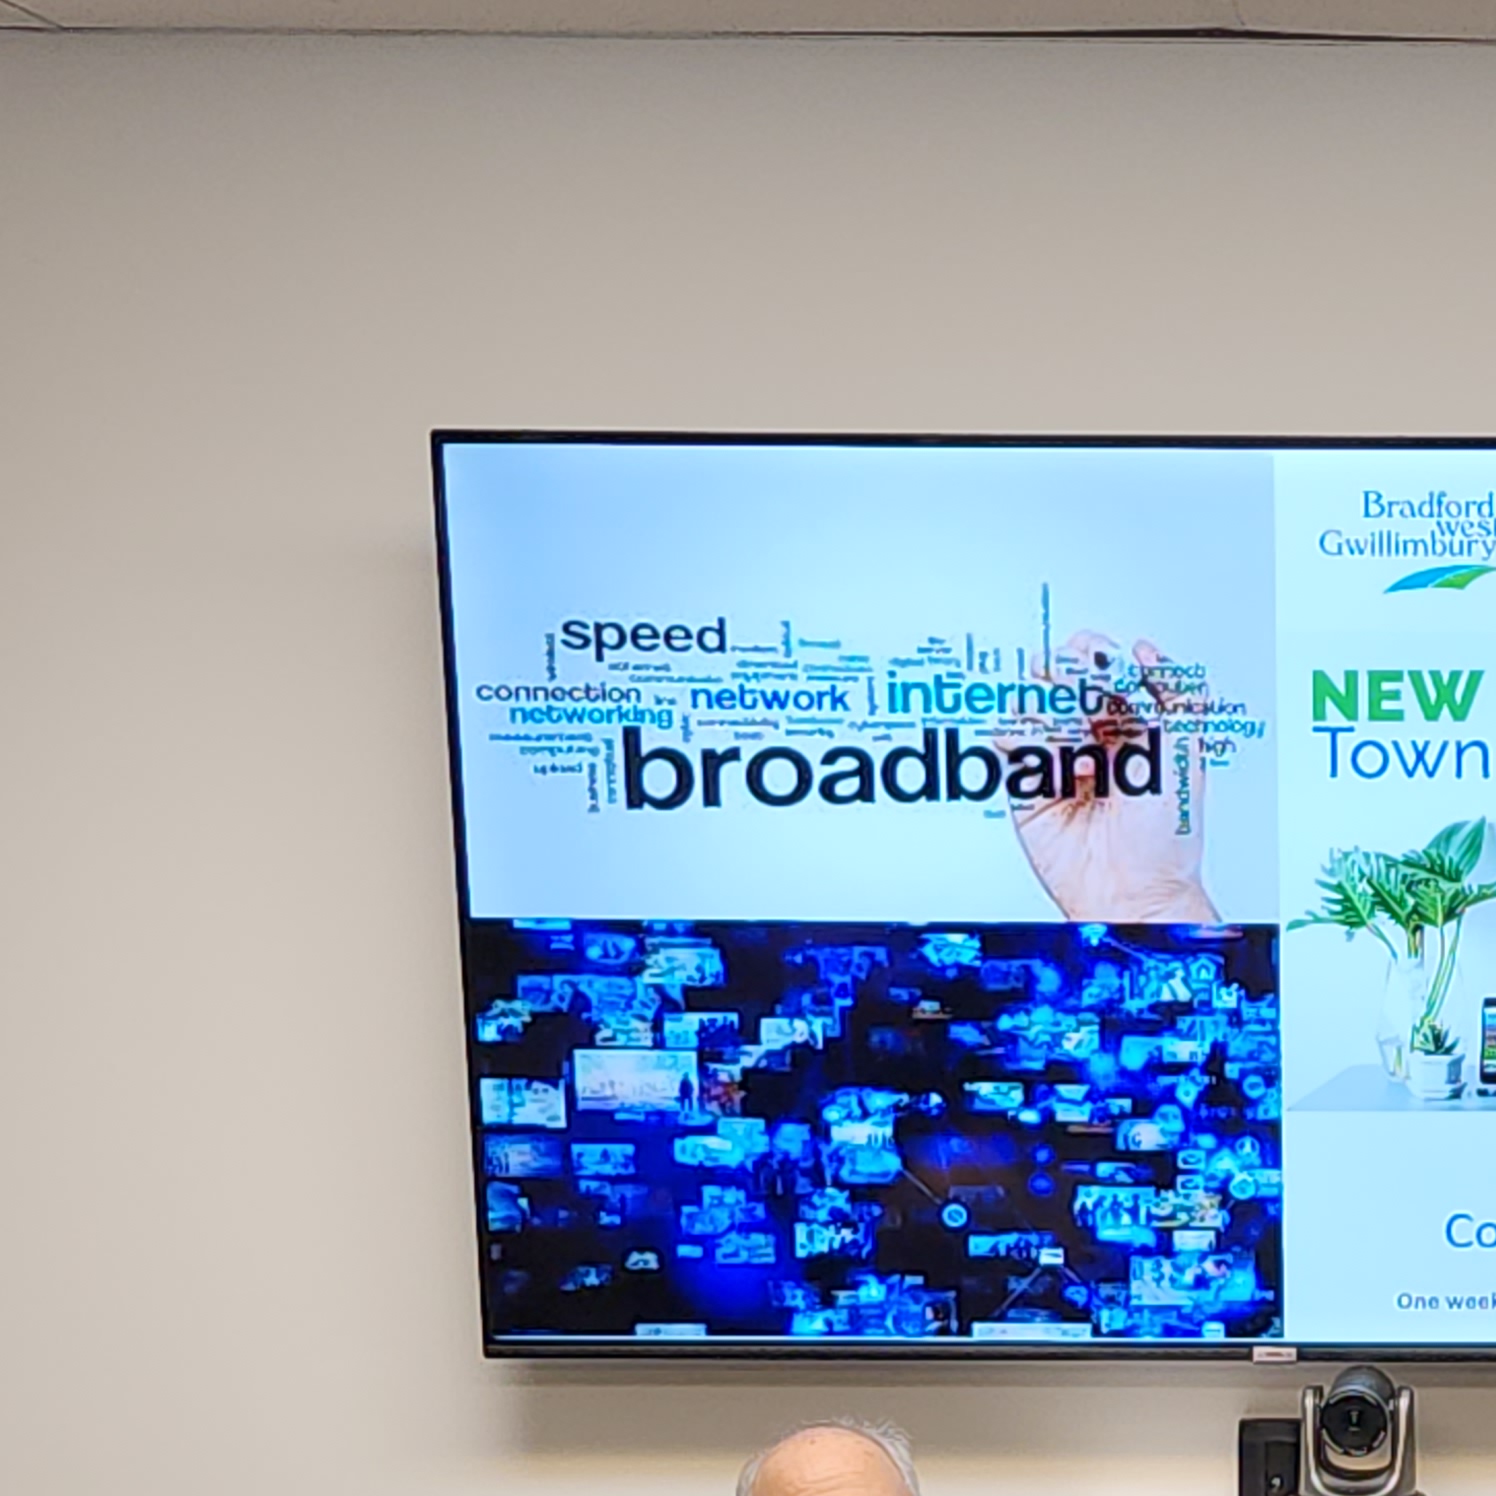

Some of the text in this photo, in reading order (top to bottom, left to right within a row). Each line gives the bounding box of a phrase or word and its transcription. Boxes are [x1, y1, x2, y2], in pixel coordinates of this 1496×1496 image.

[1362, 490, 1495, 518] Bradford
[561, 617, 727, 662] speed
[476, 681, 642, 704] connection
[691, 683, 852, 712] network
[887, 670, 1108, 716] internet
[1312, 670, 1485, 722] NEW
[510, 705, 674, 730] networking
[1164, 718, 1267, 739] technology
[1198, 736, 1237, 757] high
[1312, 726, 1490, 780] Town
[622, 725, 1162, 811] broadband
[1172, 735, 1192, 836] bandwidth
[1396, 1292, 1439, 1311] One
